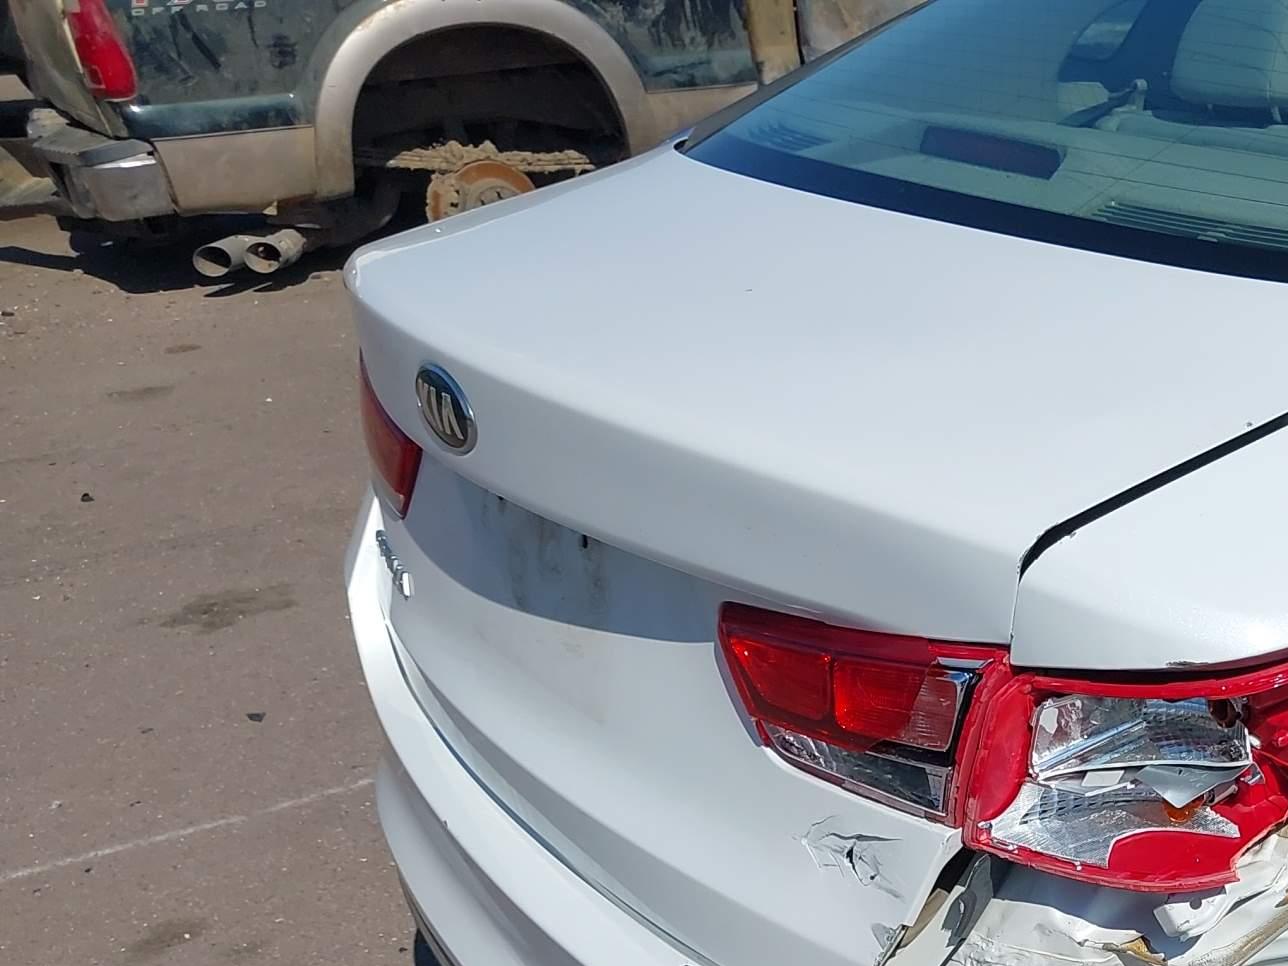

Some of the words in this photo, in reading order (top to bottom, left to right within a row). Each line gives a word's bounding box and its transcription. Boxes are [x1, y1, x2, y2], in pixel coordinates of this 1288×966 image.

[131, 6, 184, 16] OFF
[195, 1, 267, 12] ROAD
[416, 378, 465, 440] KIA
